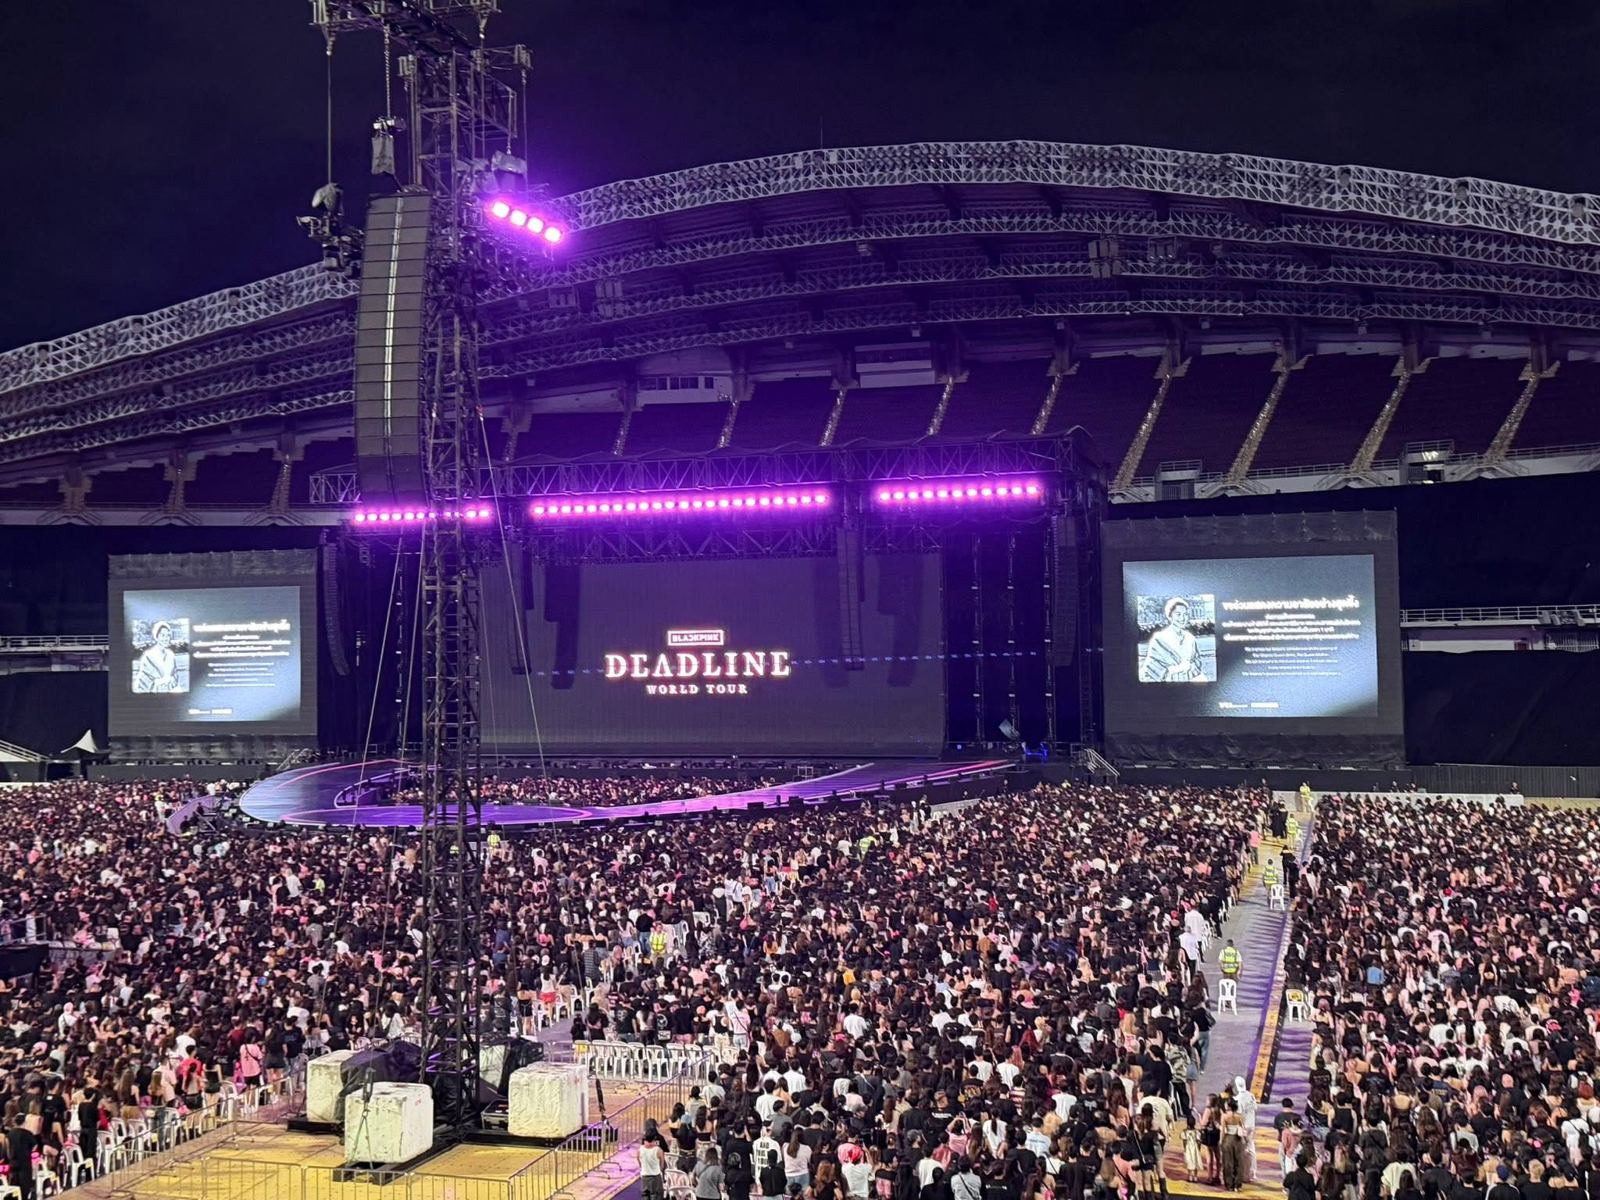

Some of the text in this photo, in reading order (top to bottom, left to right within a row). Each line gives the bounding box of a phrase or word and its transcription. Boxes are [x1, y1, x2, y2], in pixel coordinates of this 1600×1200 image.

[605, 652, 790, 678] DEADLINE
[646, 684, 748, 695] WORLD TOUR
